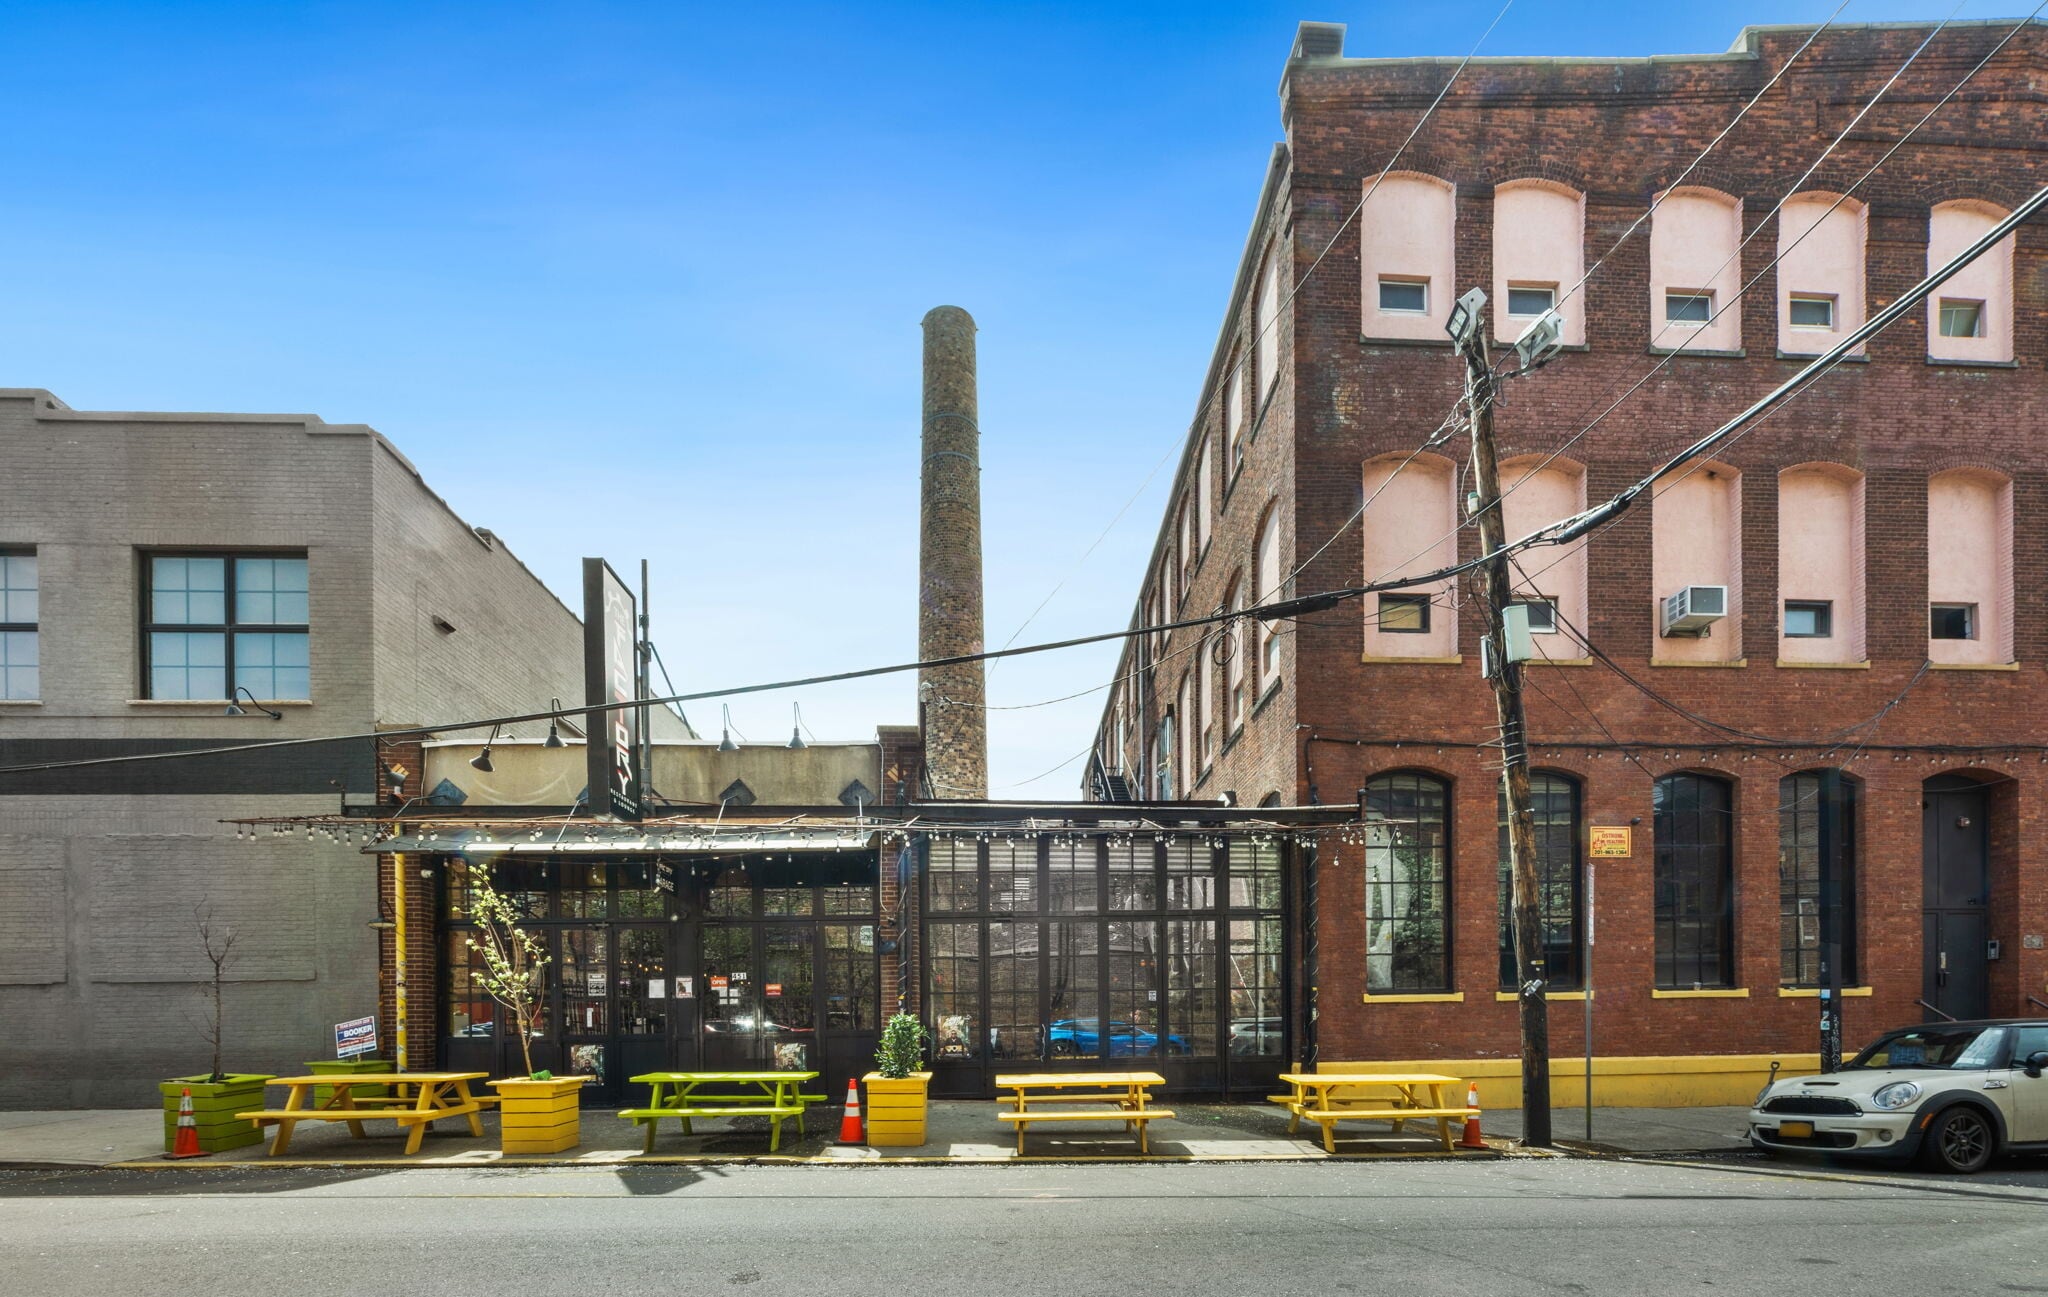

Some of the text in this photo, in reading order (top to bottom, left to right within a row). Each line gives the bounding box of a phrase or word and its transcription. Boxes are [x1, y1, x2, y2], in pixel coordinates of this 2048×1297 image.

[610, 787, 638, 809] RESTAURANT
[618, 800, 636, 815] LOUNGE
[343, 1024, 373, 1038] BOOKER
